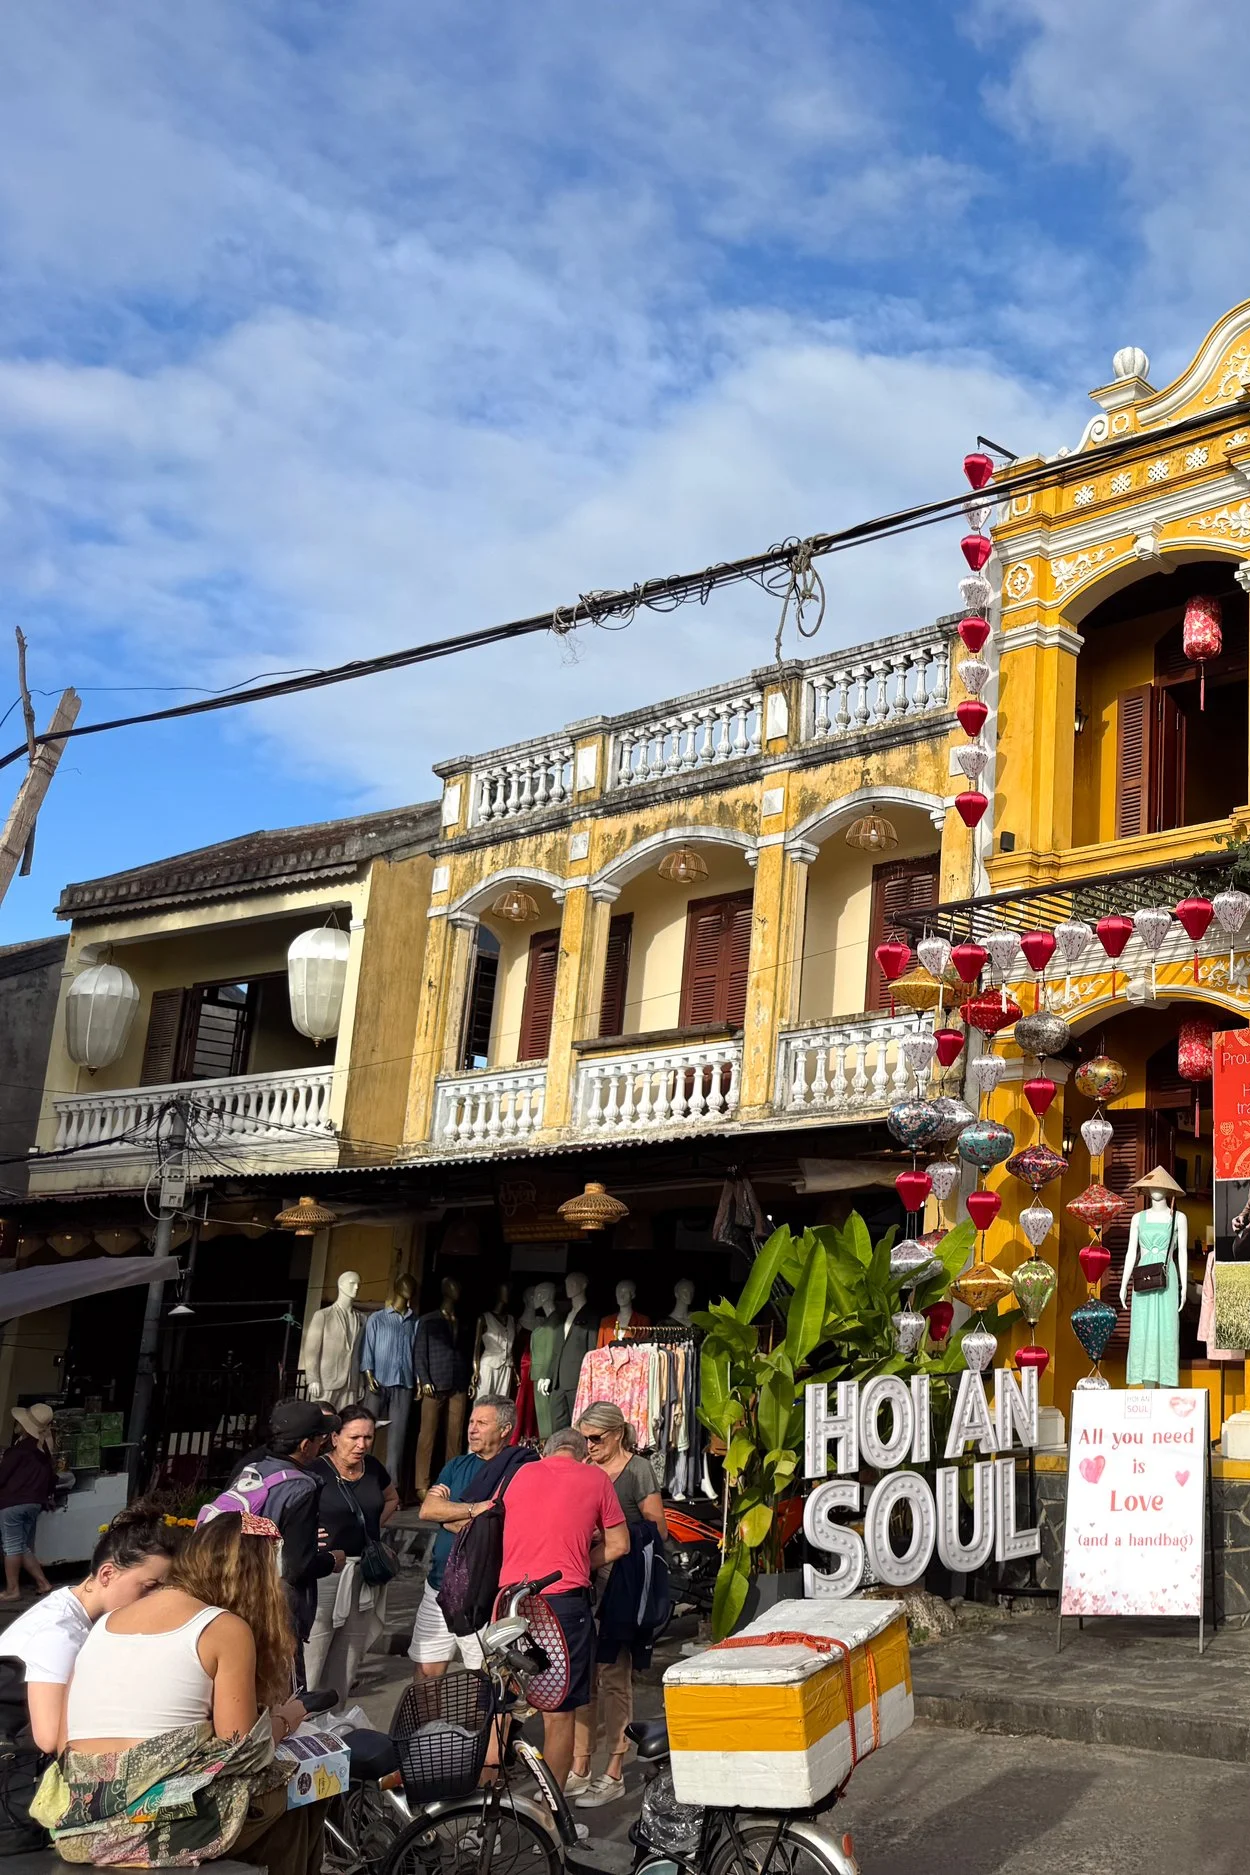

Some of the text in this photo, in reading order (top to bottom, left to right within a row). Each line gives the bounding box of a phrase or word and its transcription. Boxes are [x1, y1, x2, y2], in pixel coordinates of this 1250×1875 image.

[1126, 1405, 1149, 1413] SOUL
[804, 1366, 1039, 1479] HOI AN
[1079, 1428, 1194, 1450] All you need
[1133, 1458, 1146, 1474] is
[1110, 1490, 1164, 1512] Love
[803, 1457, 1041, 1600] SOUL
[1078, 1533, 1193, 1552] (and a handbag)
